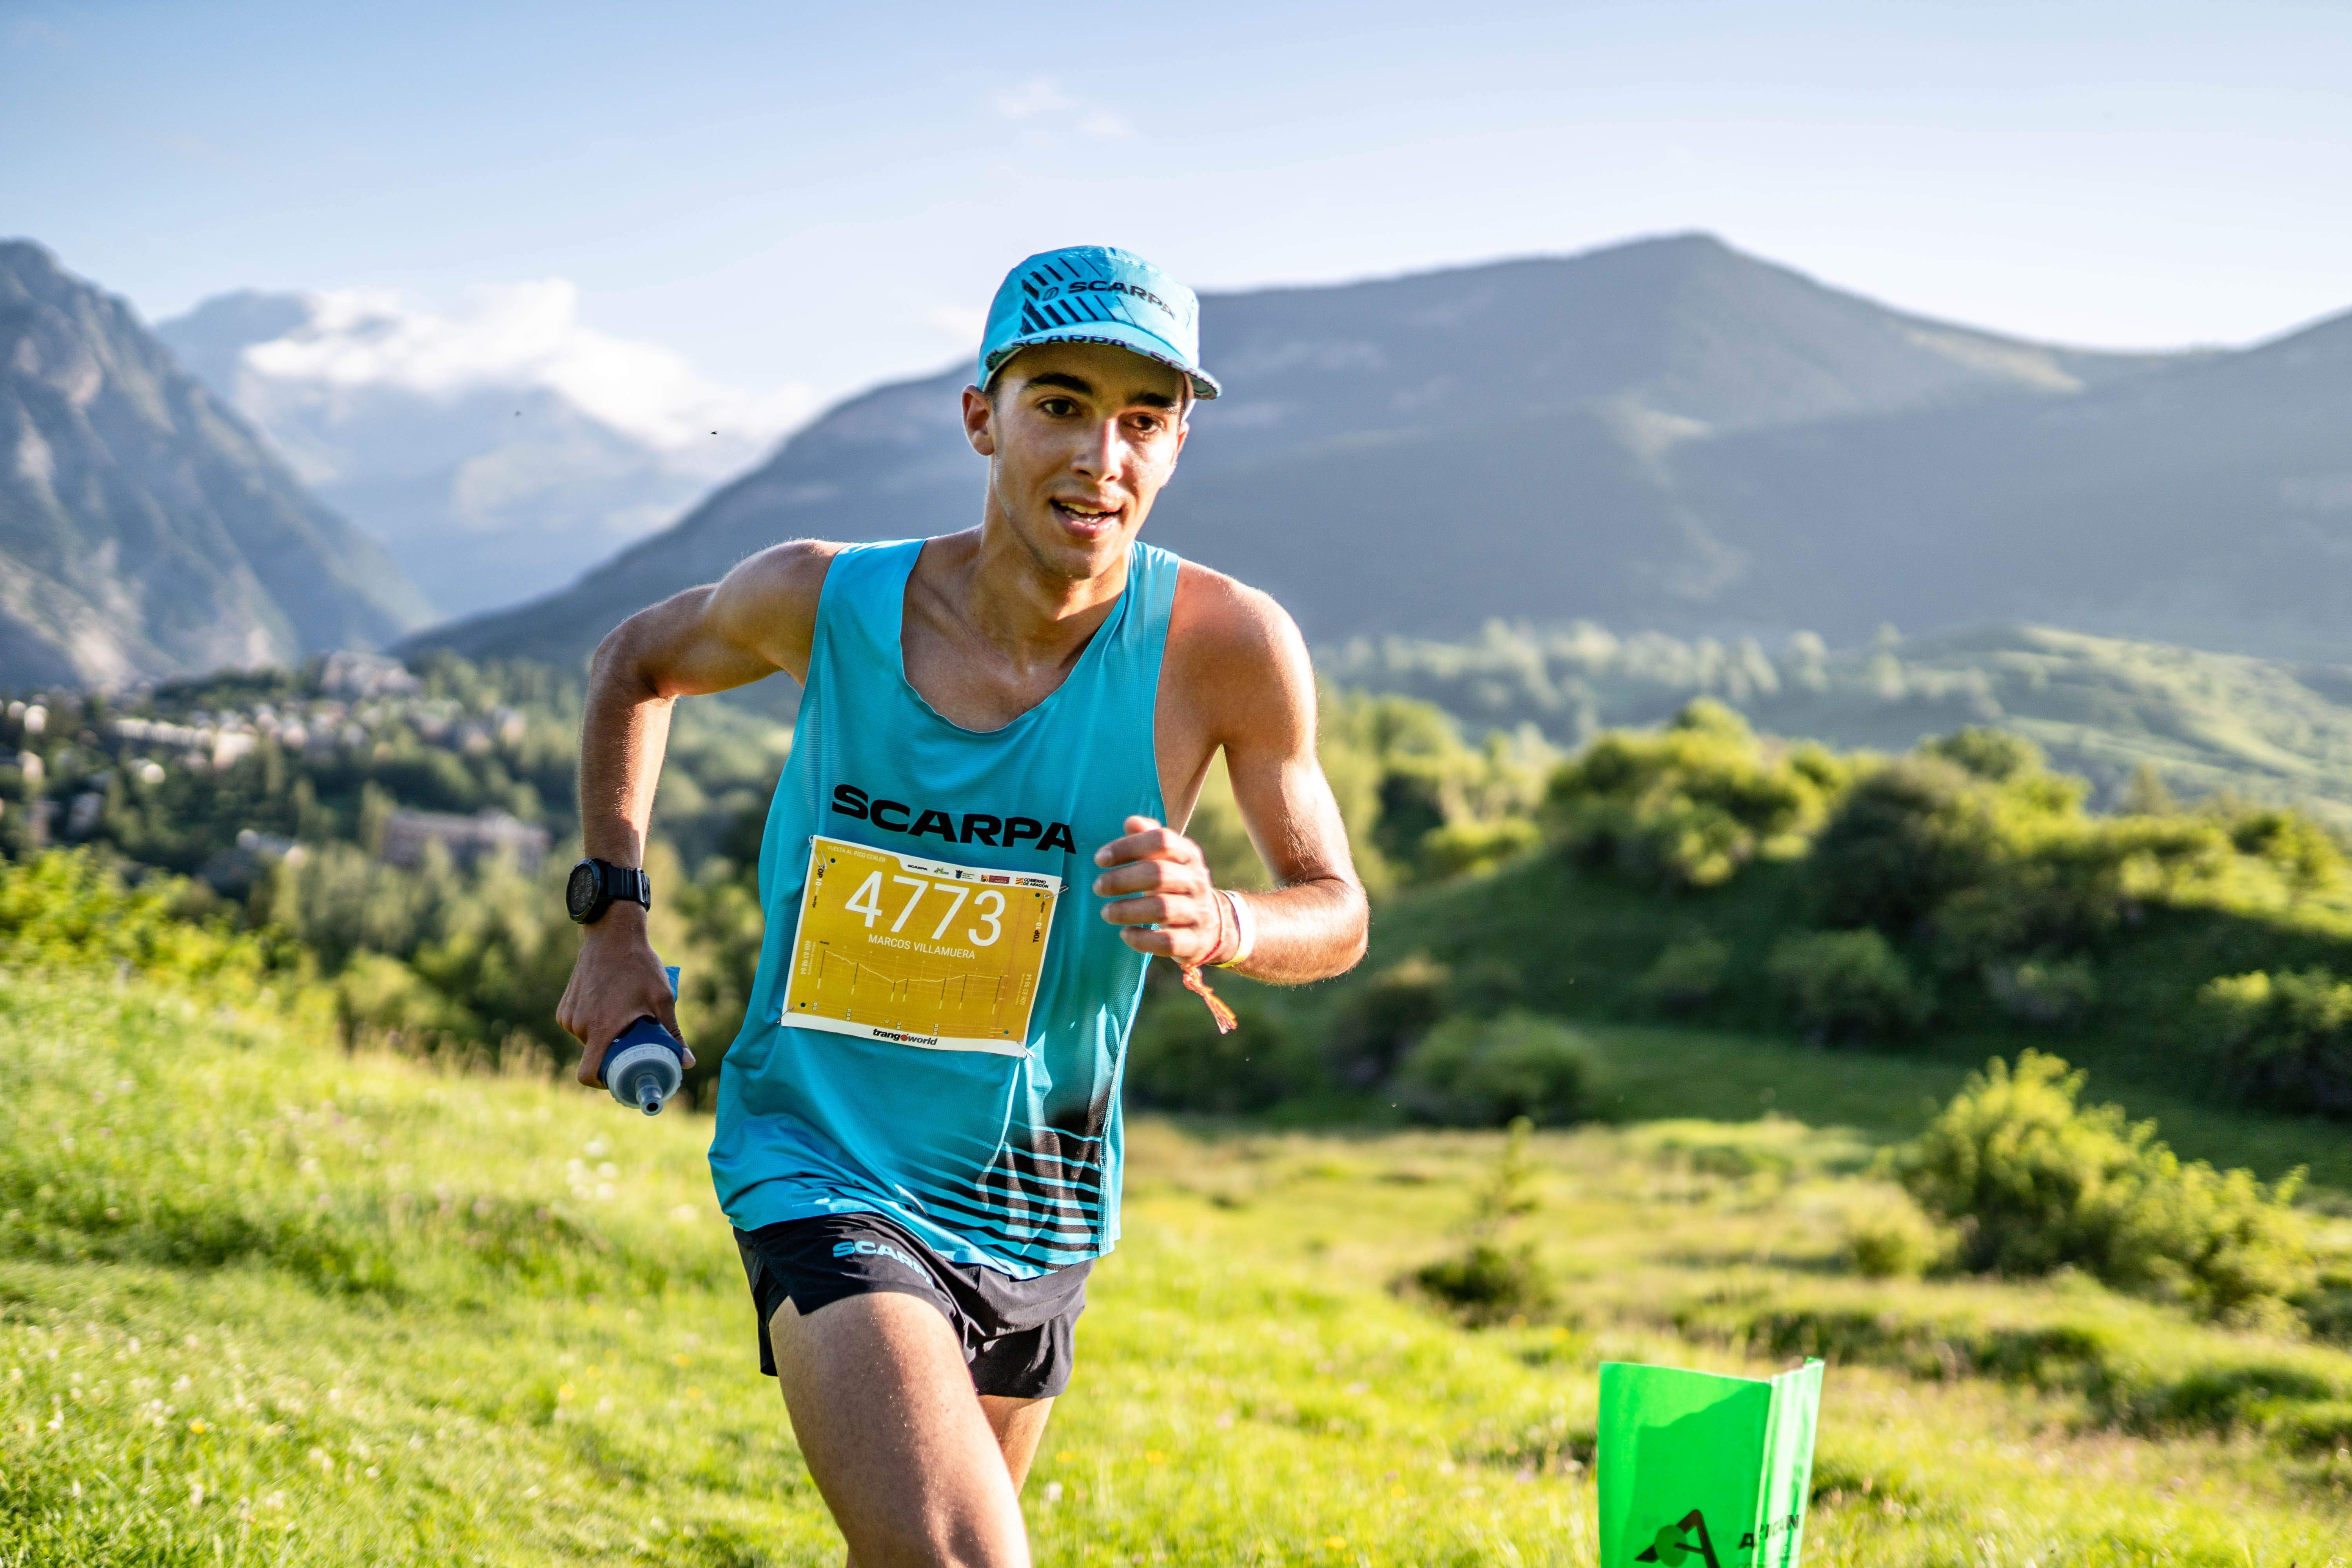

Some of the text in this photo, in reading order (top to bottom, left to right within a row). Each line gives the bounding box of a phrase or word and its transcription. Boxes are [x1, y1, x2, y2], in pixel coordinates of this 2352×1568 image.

[1068, 280, 1175, 320] SCARPA
[832, 784, 1076, 854] SCARPA
[827, 845, 845, 853] VUELTA
[845, 870, 1006, 947] 4773
[868, 934, 975, 959] MARCOS VILLAMUERA
